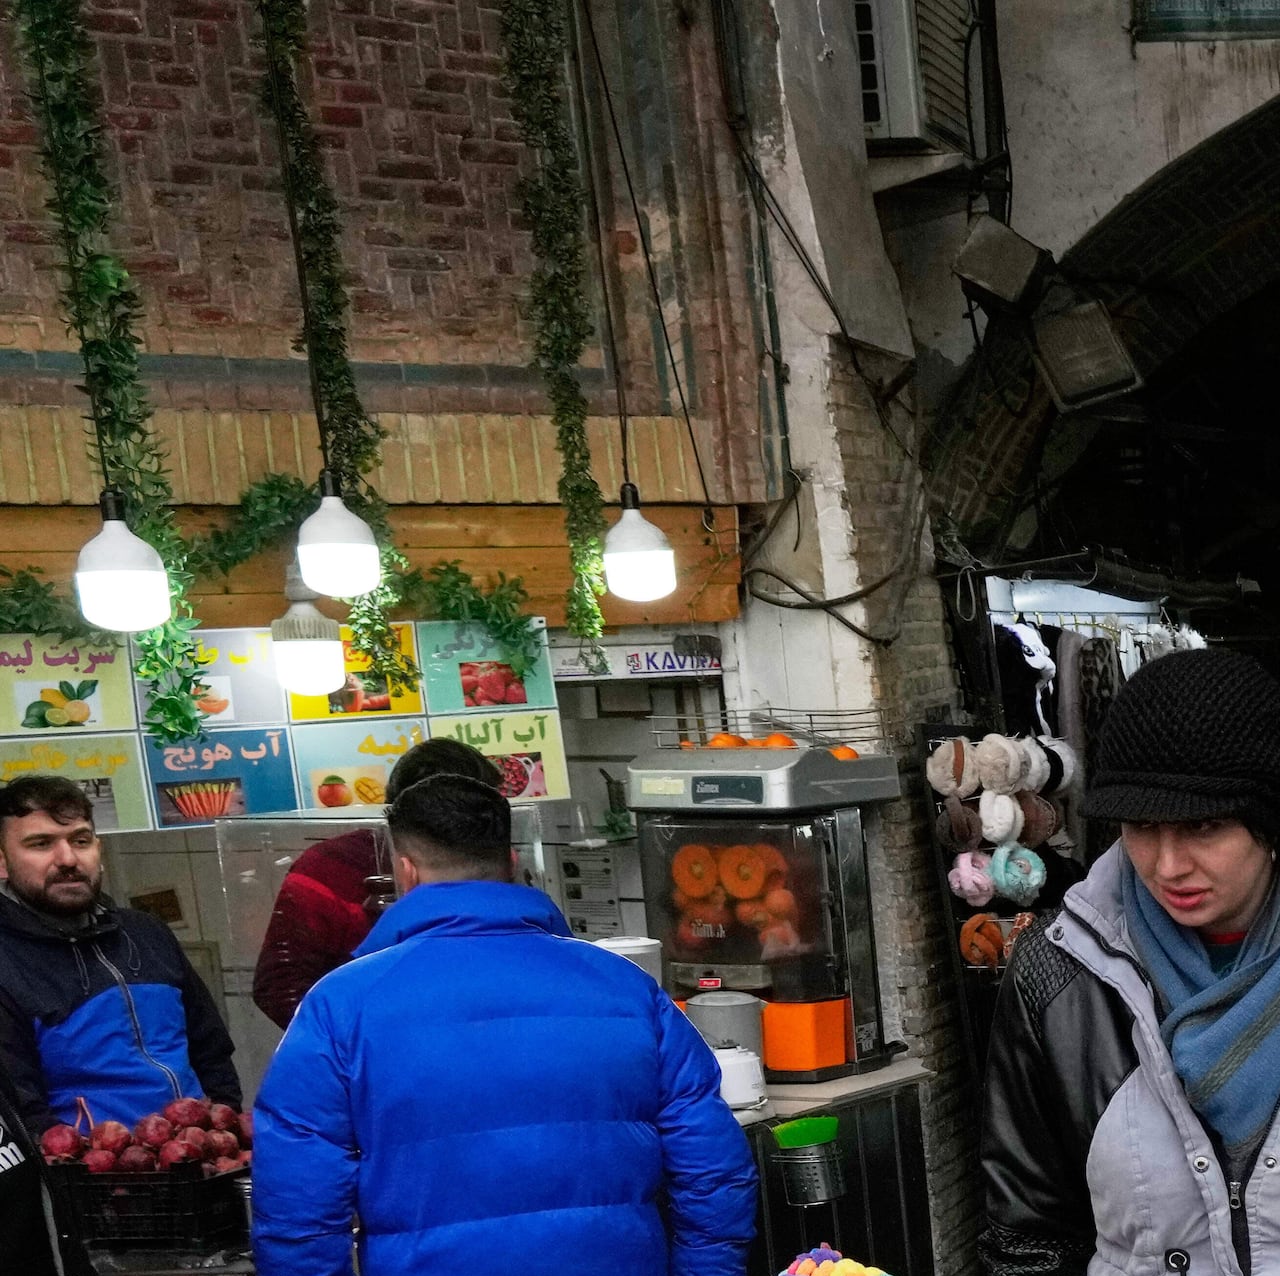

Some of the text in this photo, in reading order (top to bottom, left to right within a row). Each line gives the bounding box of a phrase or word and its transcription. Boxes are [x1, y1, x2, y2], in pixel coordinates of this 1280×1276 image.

[0, 639, 33, 673] لیم
[513, 715, 549, 748] آب
[163, 730, 282, 772] آب هویج
